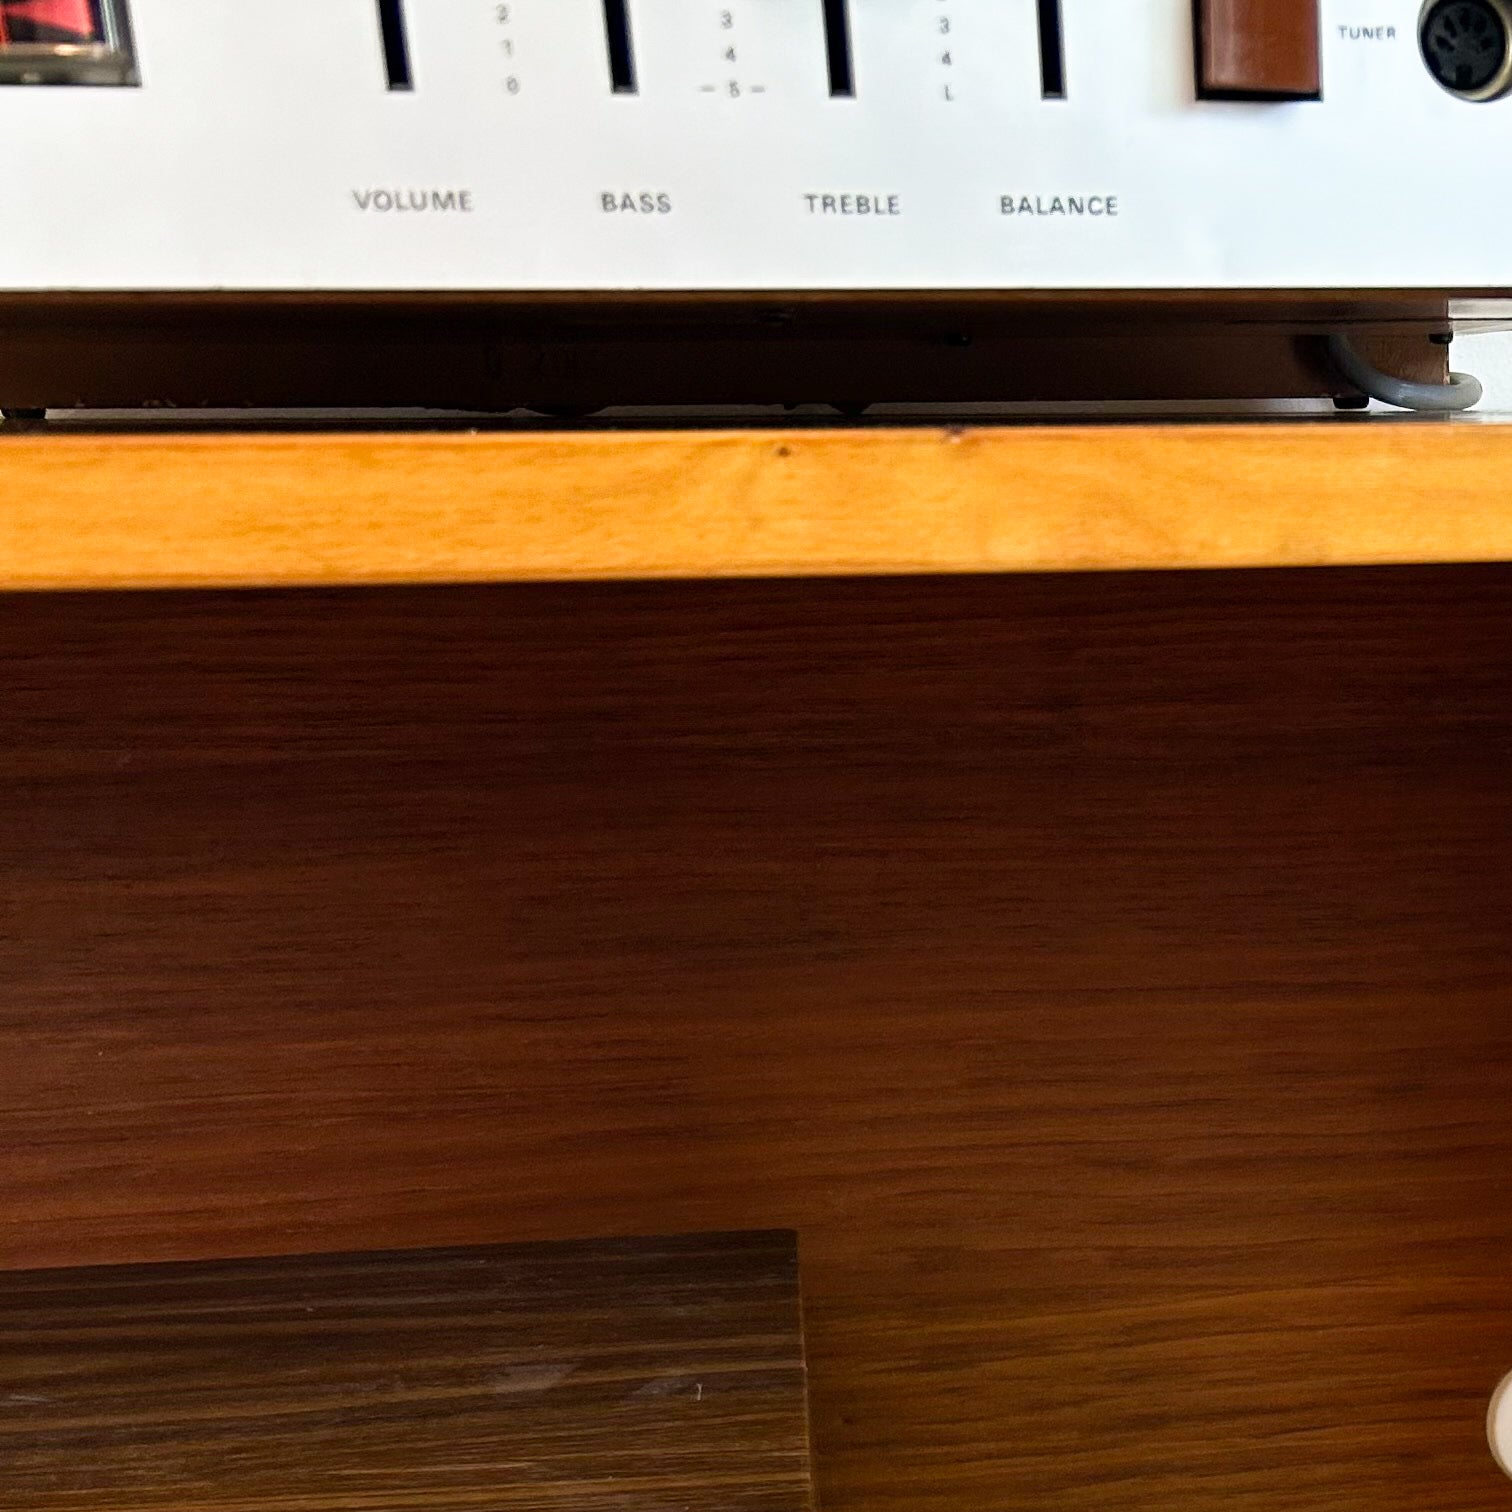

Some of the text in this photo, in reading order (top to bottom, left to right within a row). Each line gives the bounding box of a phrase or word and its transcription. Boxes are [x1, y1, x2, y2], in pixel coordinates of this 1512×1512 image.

[1338, 26, 1396, 40] TUNER
[353, 190, 472, 211] VOLUME
[602, 193, 671, 214] BASS
[804, 193, 900, 215] TREBLE
[1000, 196, 1118, 216] BALANCE
